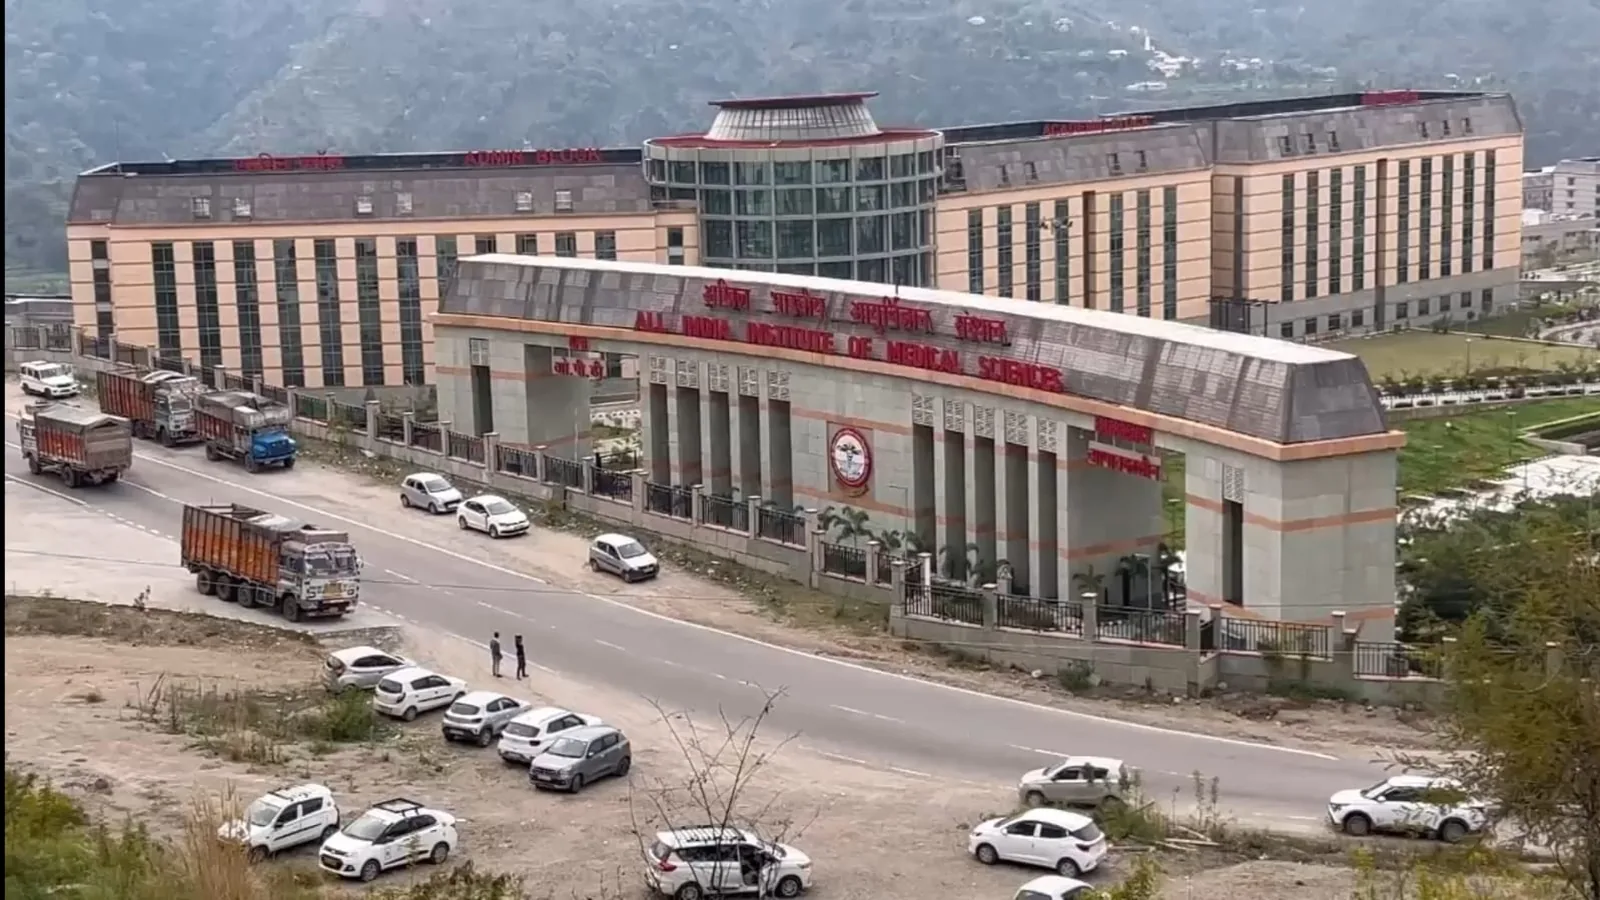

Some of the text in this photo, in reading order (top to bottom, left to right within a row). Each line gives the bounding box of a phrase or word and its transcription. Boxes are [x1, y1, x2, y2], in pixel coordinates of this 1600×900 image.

[464, 148, 600, 165] ADMIN BLOCK
[635, 311, 1064, 393] ALL INDIA INSTITUTE OF MEDICAL SCIENCES
